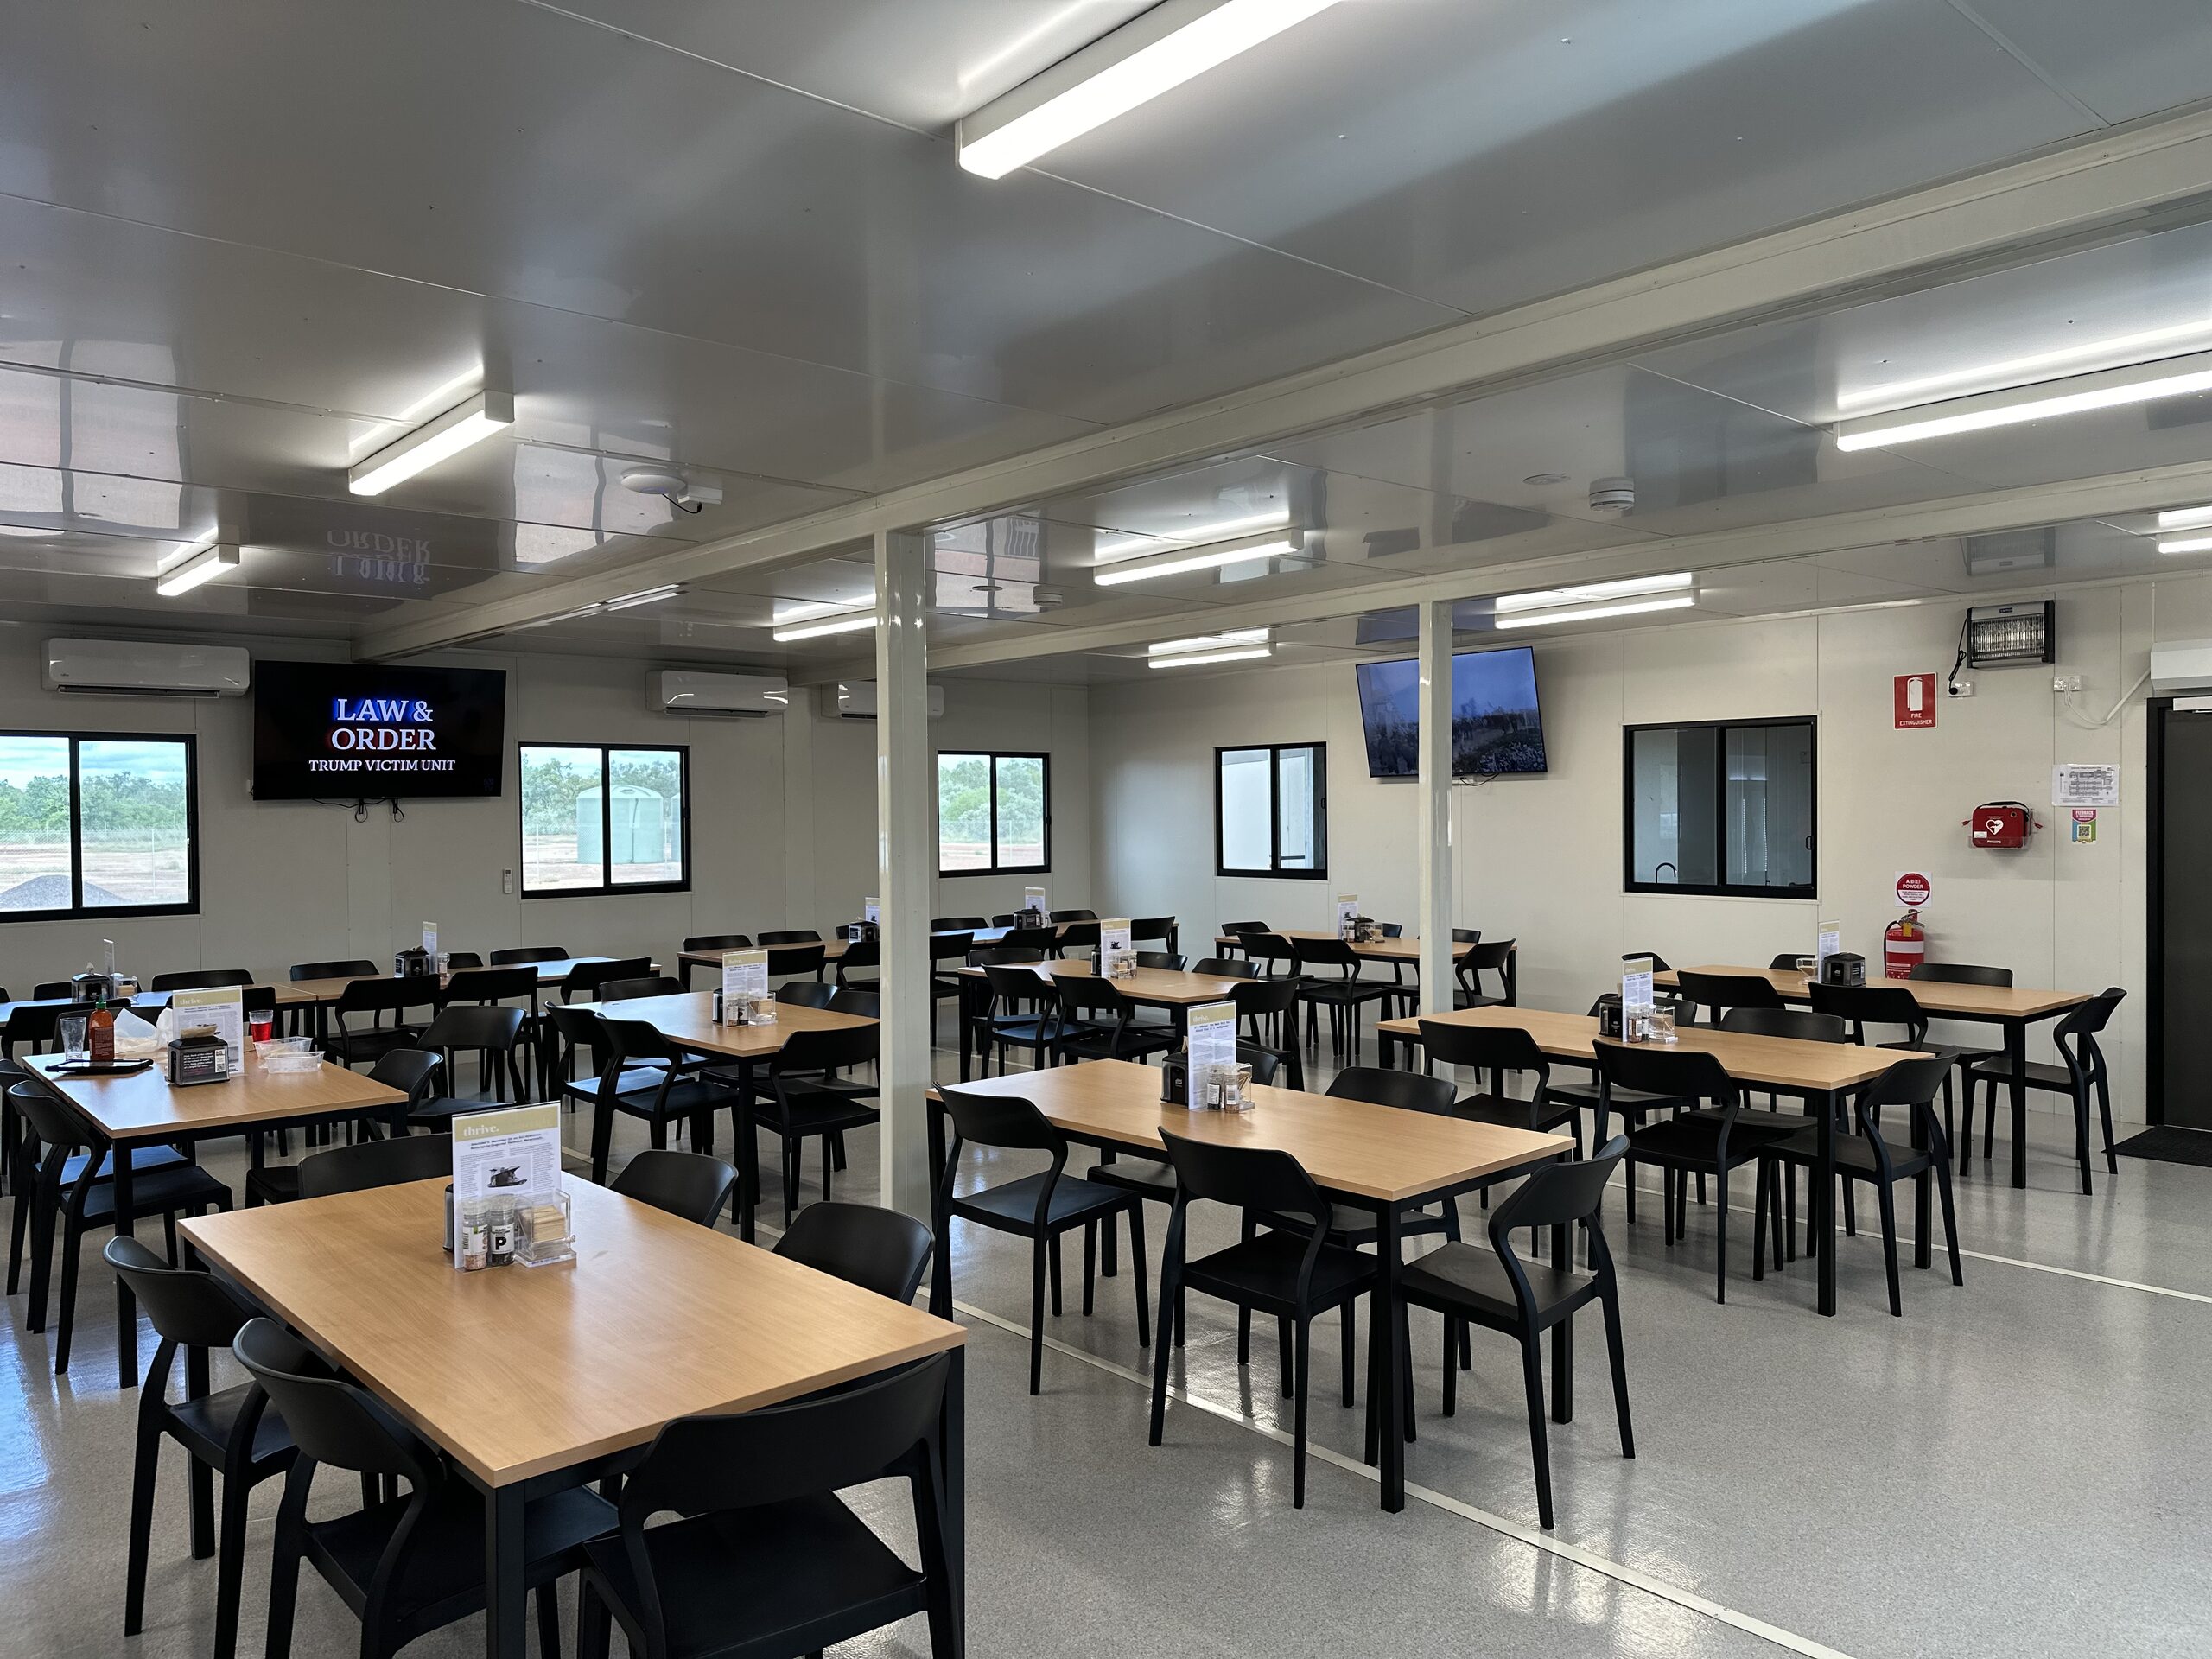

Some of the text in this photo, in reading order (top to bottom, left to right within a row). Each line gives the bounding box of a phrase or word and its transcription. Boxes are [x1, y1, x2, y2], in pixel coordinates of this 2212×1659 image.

[337, 698, 433, 722] LAW &
[331, 728, 436, 750] ORDER
[309, 760, 456, 772] TRUMP VICTIM UNIT
[463, 1125, 499, 1136] thrive.
[495, 1236, 507, 1250] P
